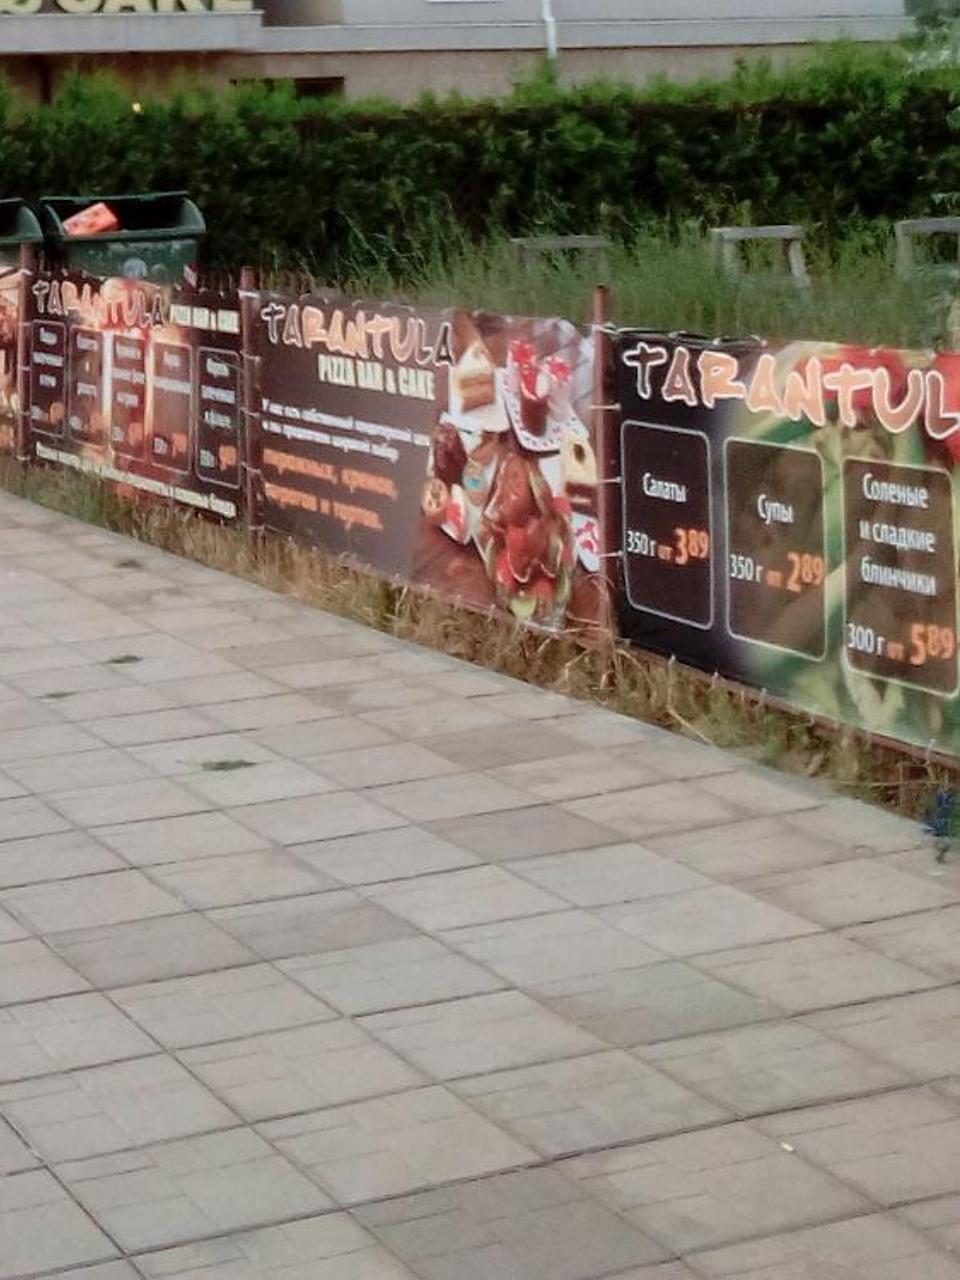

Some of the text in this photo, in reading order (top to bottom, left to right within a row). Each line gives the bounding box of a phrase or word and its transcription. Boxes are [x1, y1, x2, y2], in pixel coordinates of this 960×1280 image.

[31, 279, 167, 332] TARANTULA
[260, 302, 456, 368] TARANTULA
[642, 472, 687, 503] Салаты
[863, 473, 929, 509] Соленые
[757, 494, 795, 525] Супы
[626, 530, 650, 555] 350
[872, 521, 936, 553] сладкие
[729, 554, 755, 581] 350
[861, 556, 937, 597] блинчики
[847, 623, 875, 653] 300
